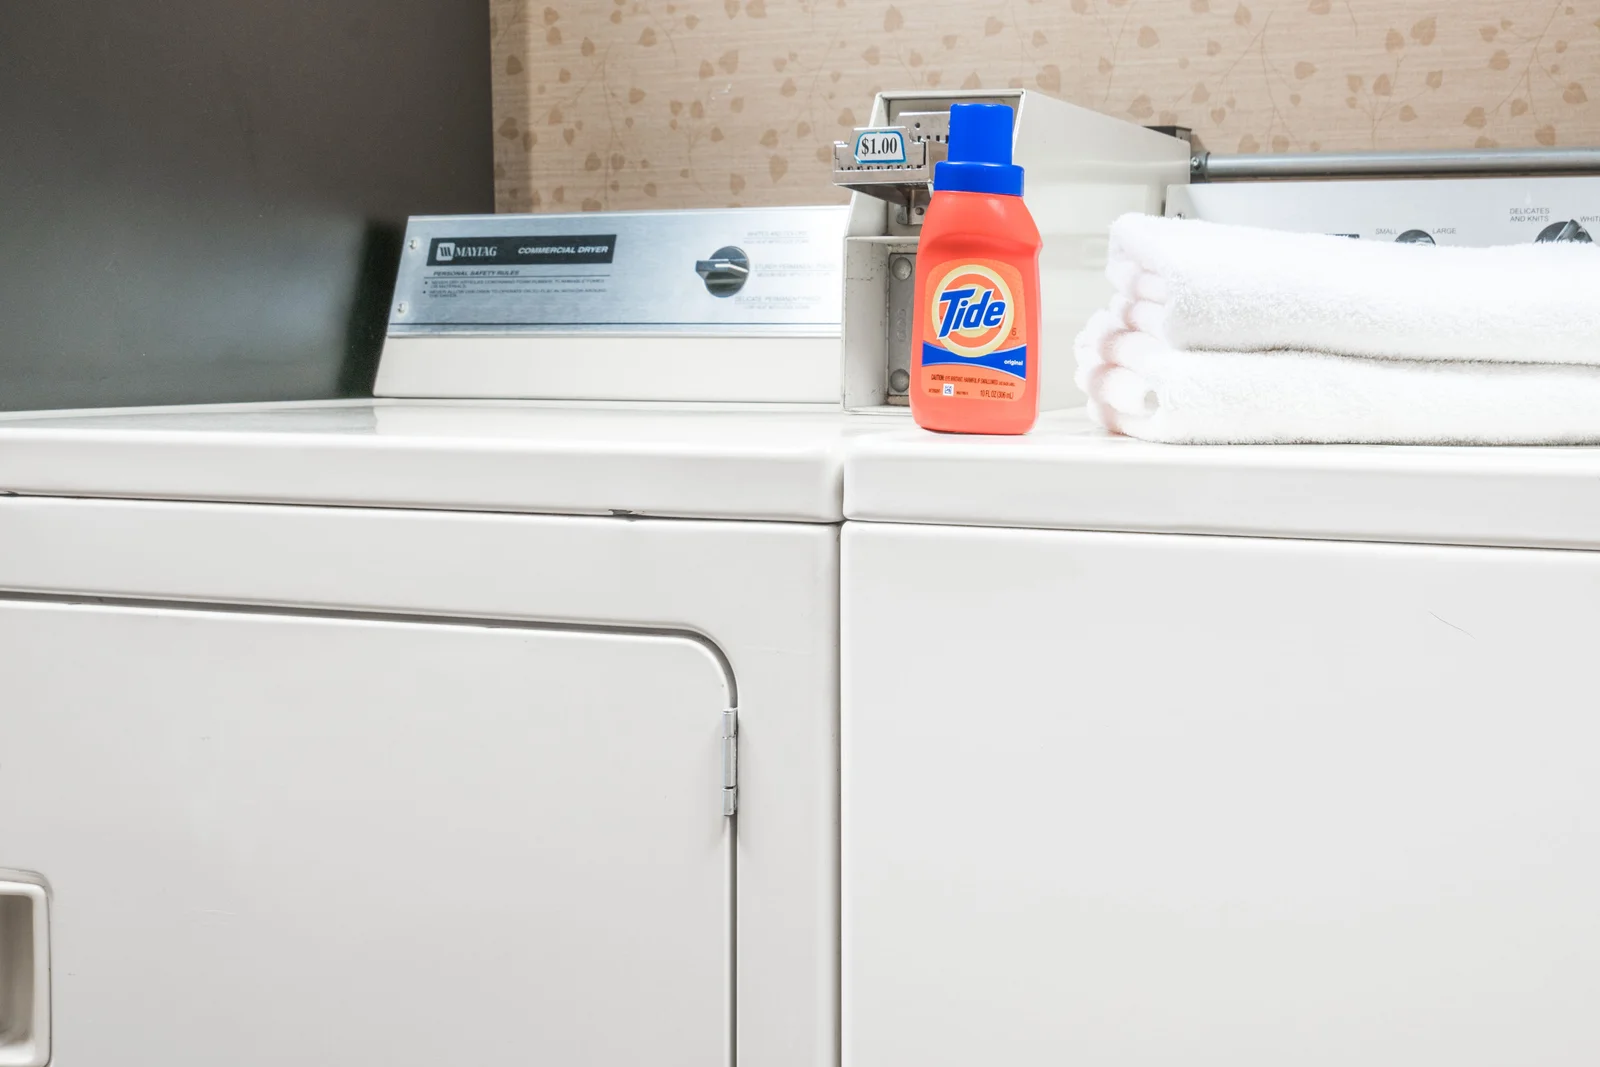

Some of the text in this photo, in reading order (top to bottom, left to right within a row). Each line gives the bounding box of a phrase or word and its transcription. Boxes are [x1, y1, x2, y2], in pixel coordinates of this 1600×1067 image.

[861, 137, 898, 156] $1.00
[1509, 207, 1550, 215] DELICATES
[1432, 227, 1457, 235] LARGE
[455, 246, 498, 257] MAYTAG
[518, 245, 609, 255] COMMERCIAL DRYER
[937, 287, 1007, 339] Tide
[1011, 327, 1017, 337] 6
[1003, 359, 1024, 367] original
[986, 389, 991, 398] FL
[991, 390, 997, 398] OZ
